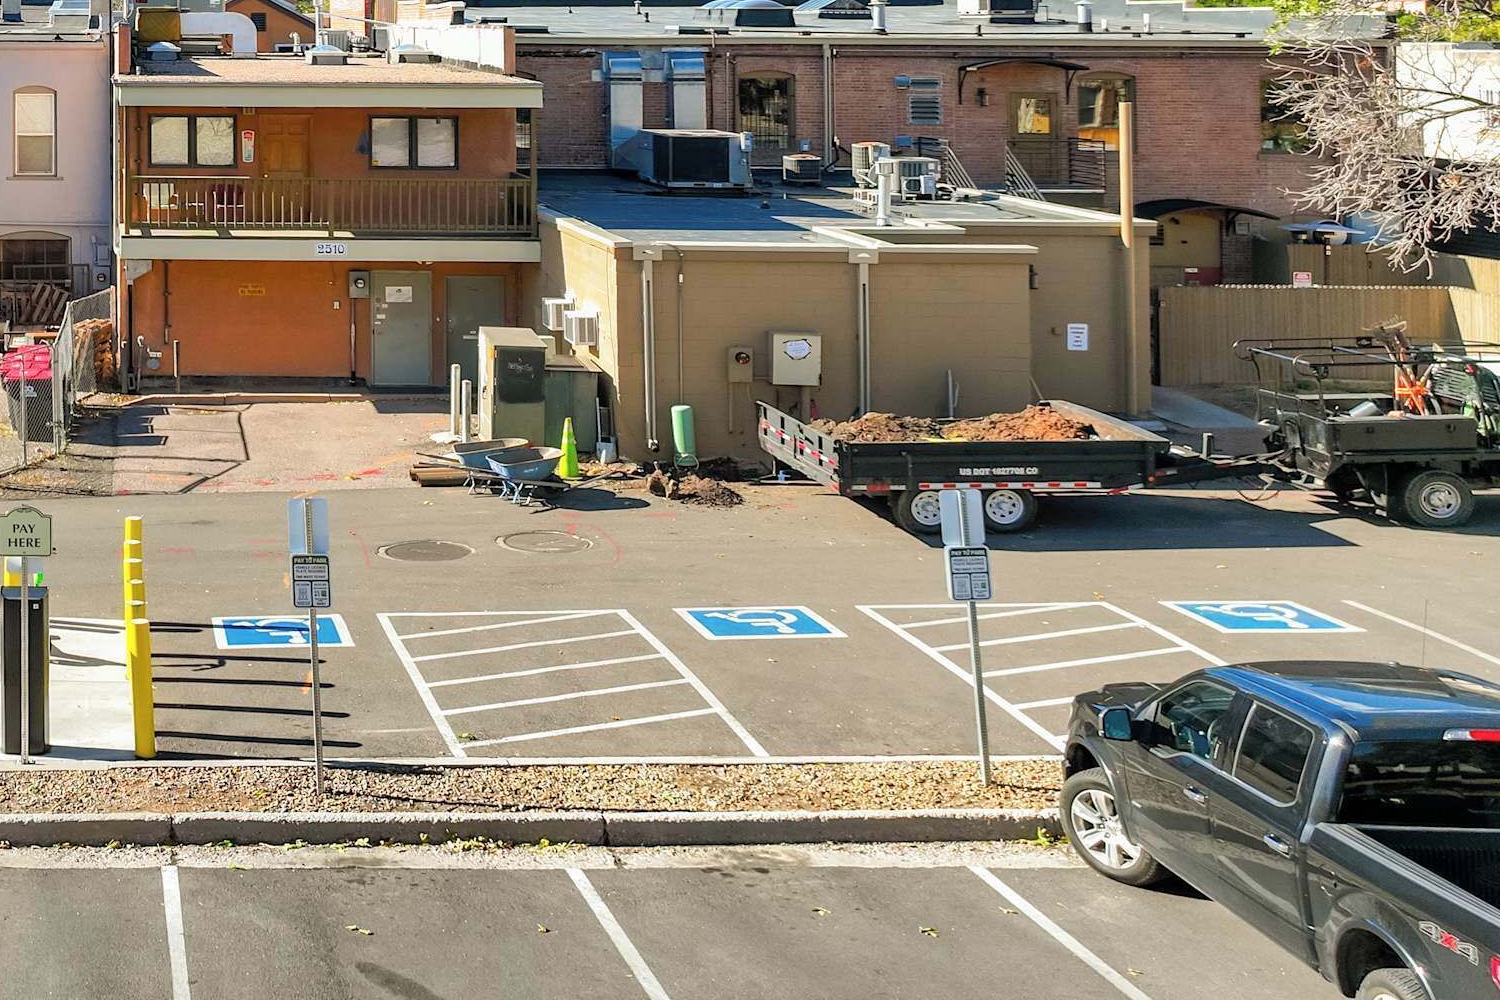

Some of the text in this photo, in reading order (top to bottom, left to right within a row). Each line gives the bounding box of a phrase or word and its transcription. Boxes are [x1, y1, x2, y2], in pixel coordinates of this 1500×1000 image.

[317, 244, 345, 254] 2510
[959, 467, 972, 476] US
[973, 467, 991, 476] DOT
[12, 523, 36, 534] PAY
[8, 537, 41, 548] HERE
